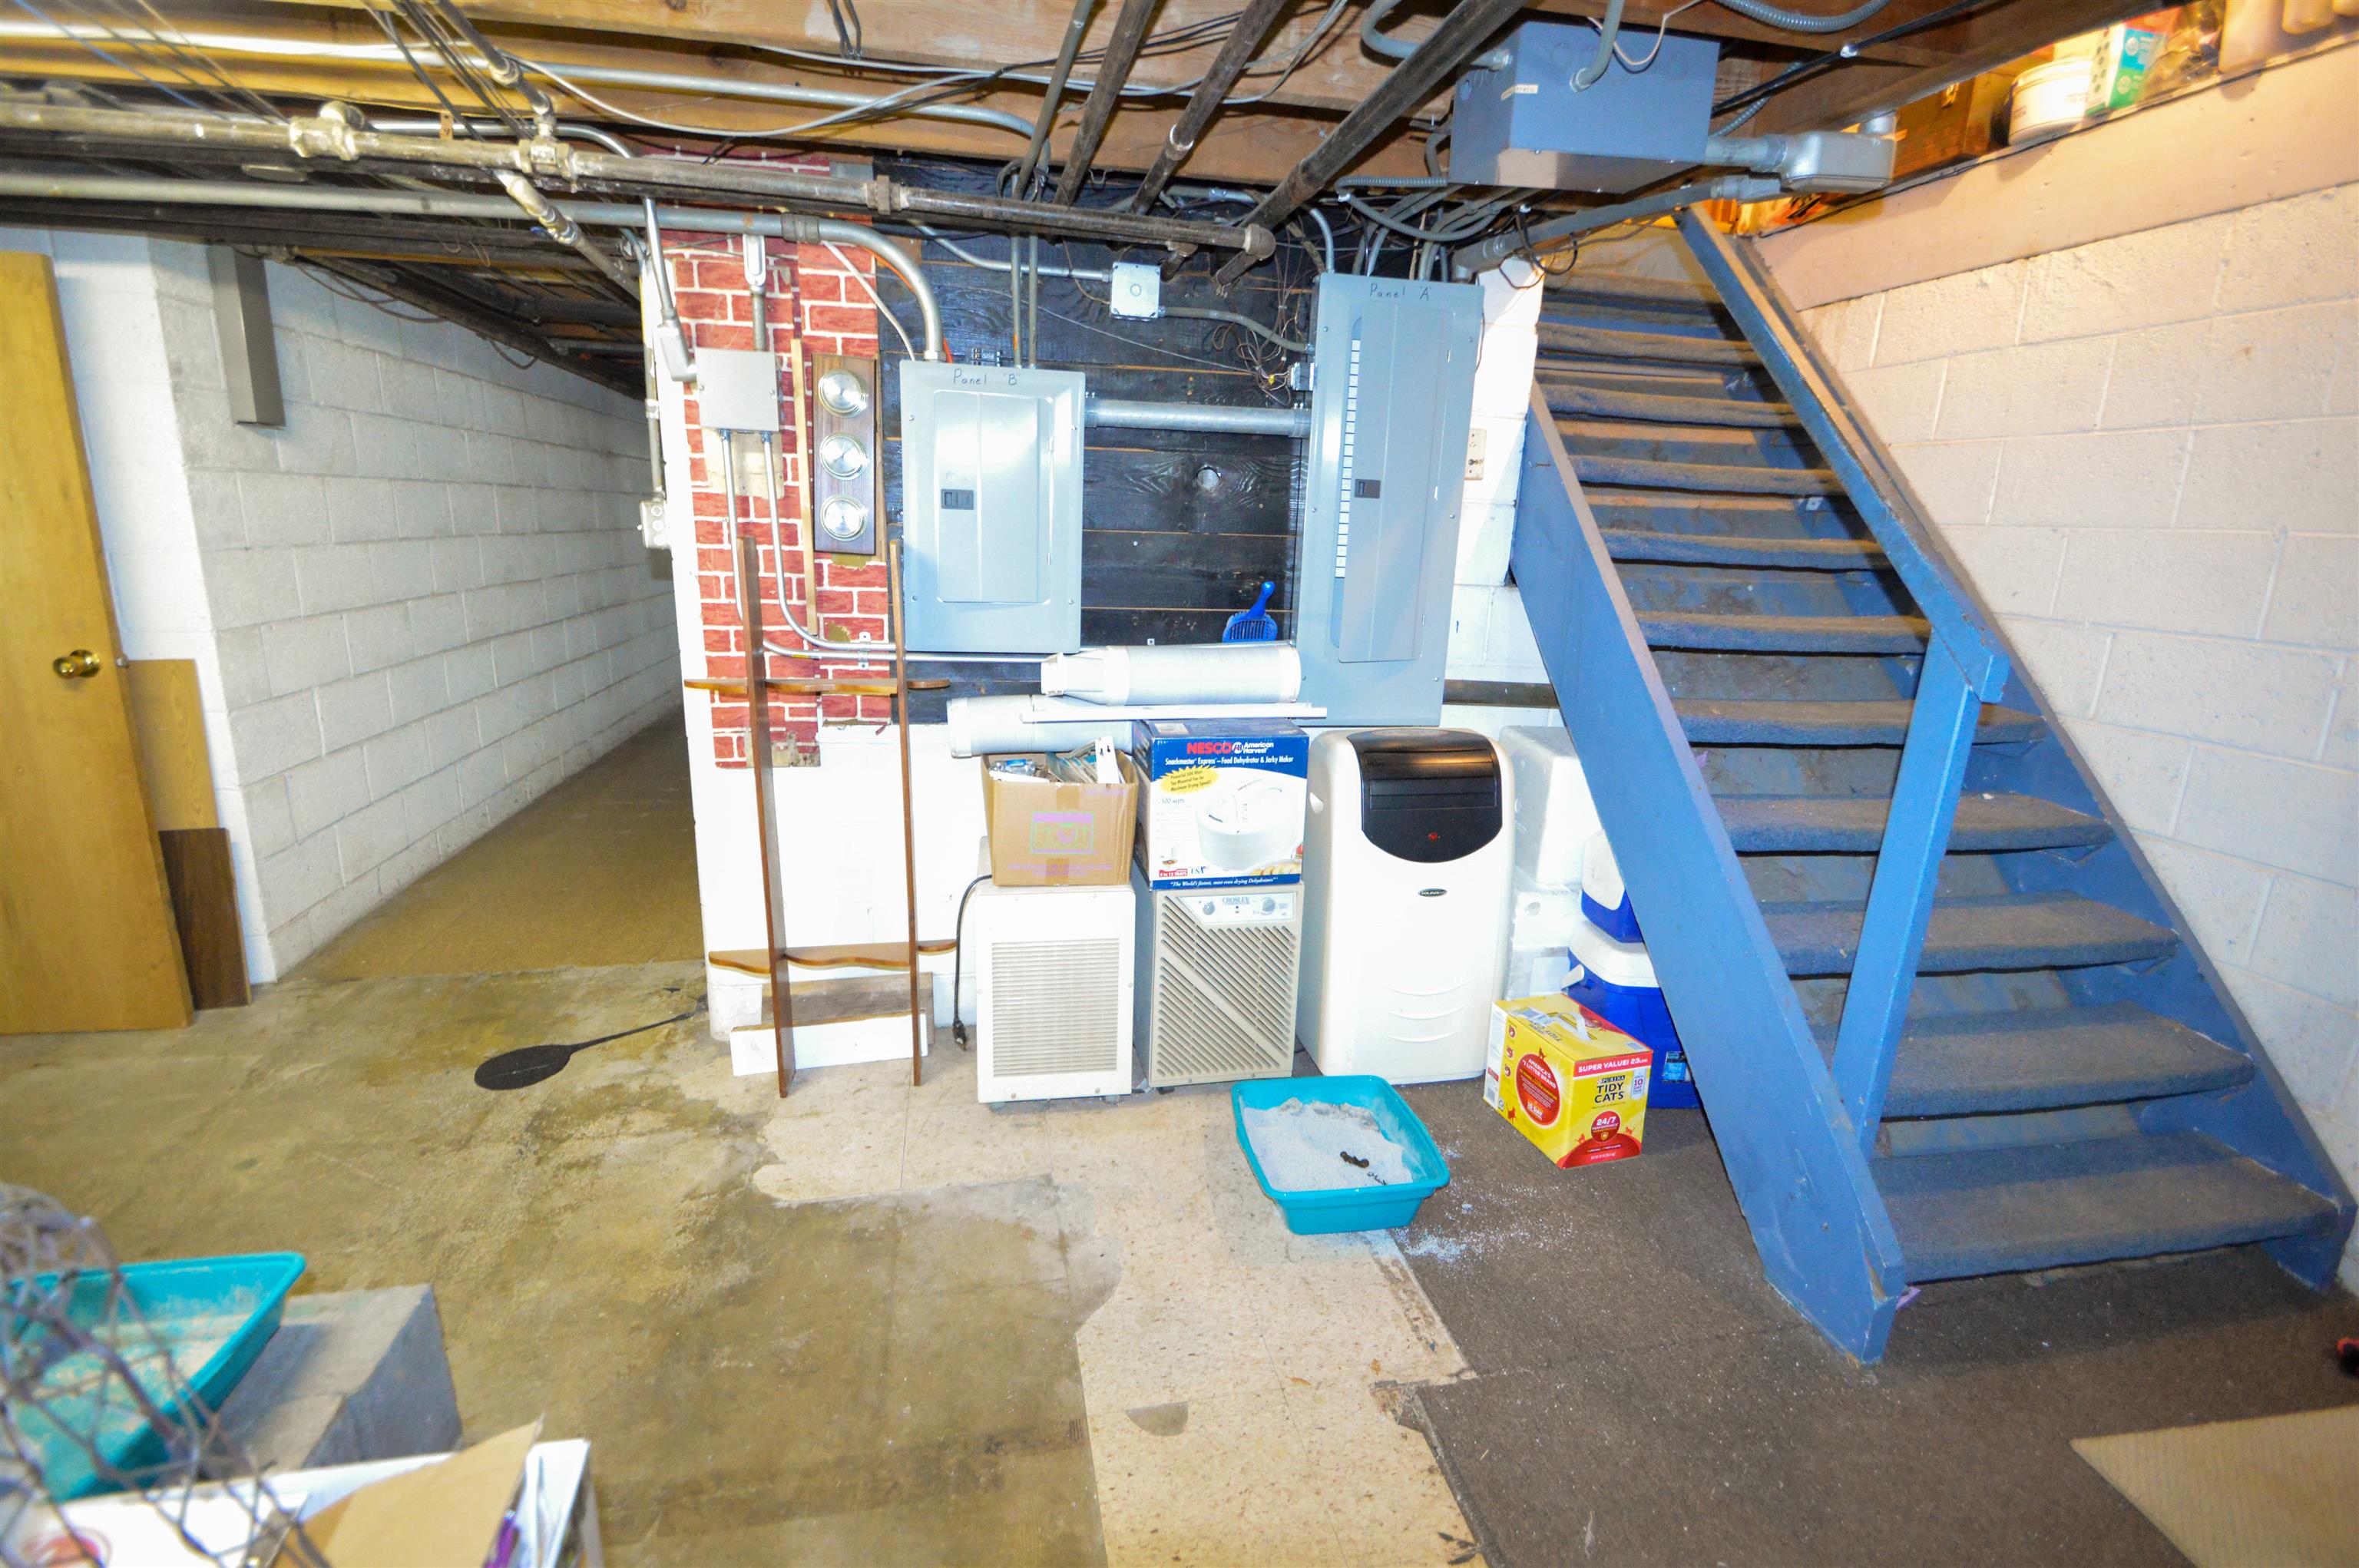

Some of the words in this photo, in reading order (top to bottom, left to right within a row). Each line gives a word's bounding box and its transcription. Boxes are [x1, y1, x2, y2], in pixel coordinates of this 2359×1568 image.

[1370, 283, 1405, 297] Panel
[953, 368, 987, 385] Panel
[1186, 742, 1232, 754] NESCO
[1165, 757, 1196, 766] Snackmaster
[1198, 757, 1216, 766] Express
[1233, 756, 1259, 765] Dehydrator
[1265, 756, 1278, 764] Jerky
[1223, 896, 1250, 905] CROSLEY
[1578, 1064, 1603, 1073] SUPER
[1603, 1060, 1629, 1069] VALUE!
[1526, 1063, 1541, 1077] LITTER
[1540, 1074, 1557, 1089] BRAND
[1597, 1083, 1623, 1093] TIDY
[1594, 1091, 1624, 1103] CATS
[1596, 1116, 1616, 1126] 24/7
